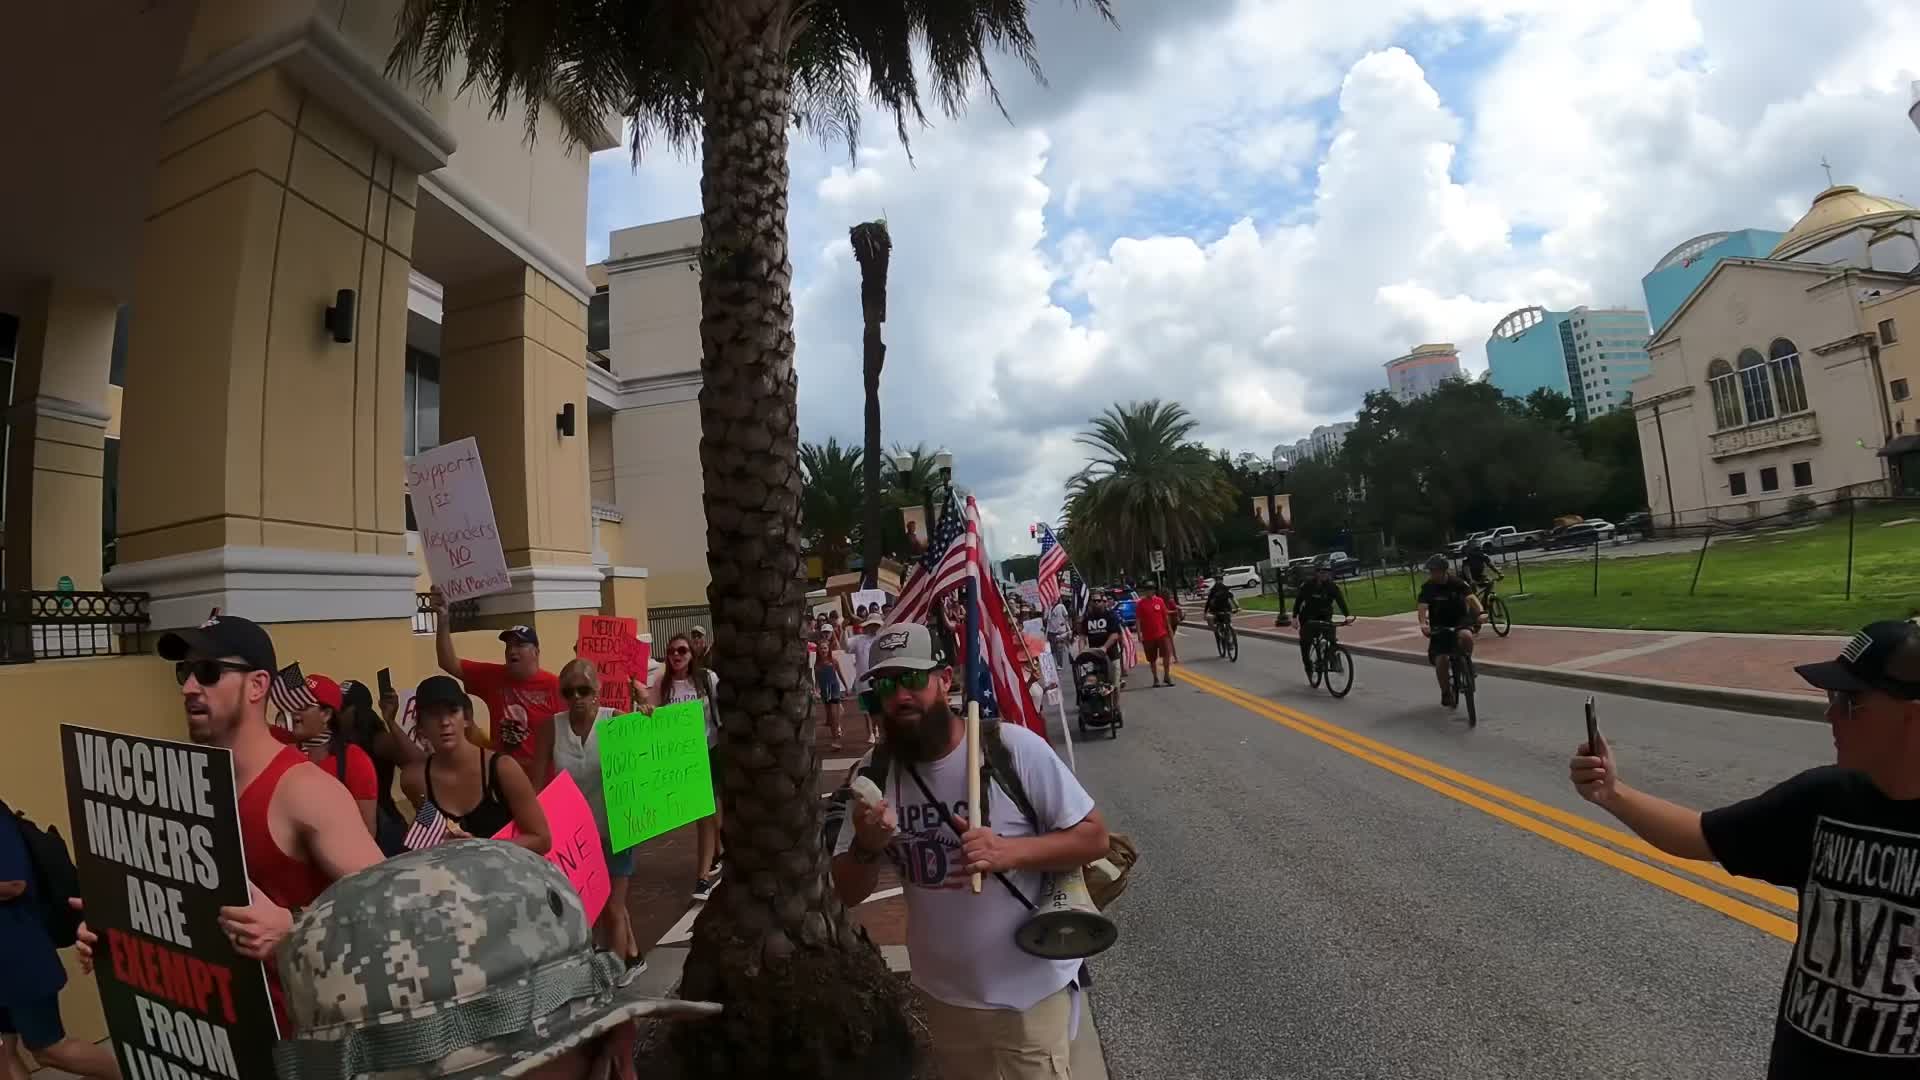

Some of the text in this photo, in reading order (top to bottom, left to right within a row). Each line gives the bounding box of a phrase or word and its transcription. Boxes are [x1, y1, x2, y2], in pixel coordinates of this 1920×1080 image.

[410, 449, 477, 489] Support
[448, 545, 472, 567] NO
[1087, 618, 1107, 630] NO
[74, 732, 215, 818] VACCINE
[84, 799, 220, 890] MAKERS
[126, 874, 193, 949] ARE
[1803, 892, 1920, 996] LIVE
[108, 927, 238, 1025] EXEMPT
[135, 995, 240, 1080] FROM
